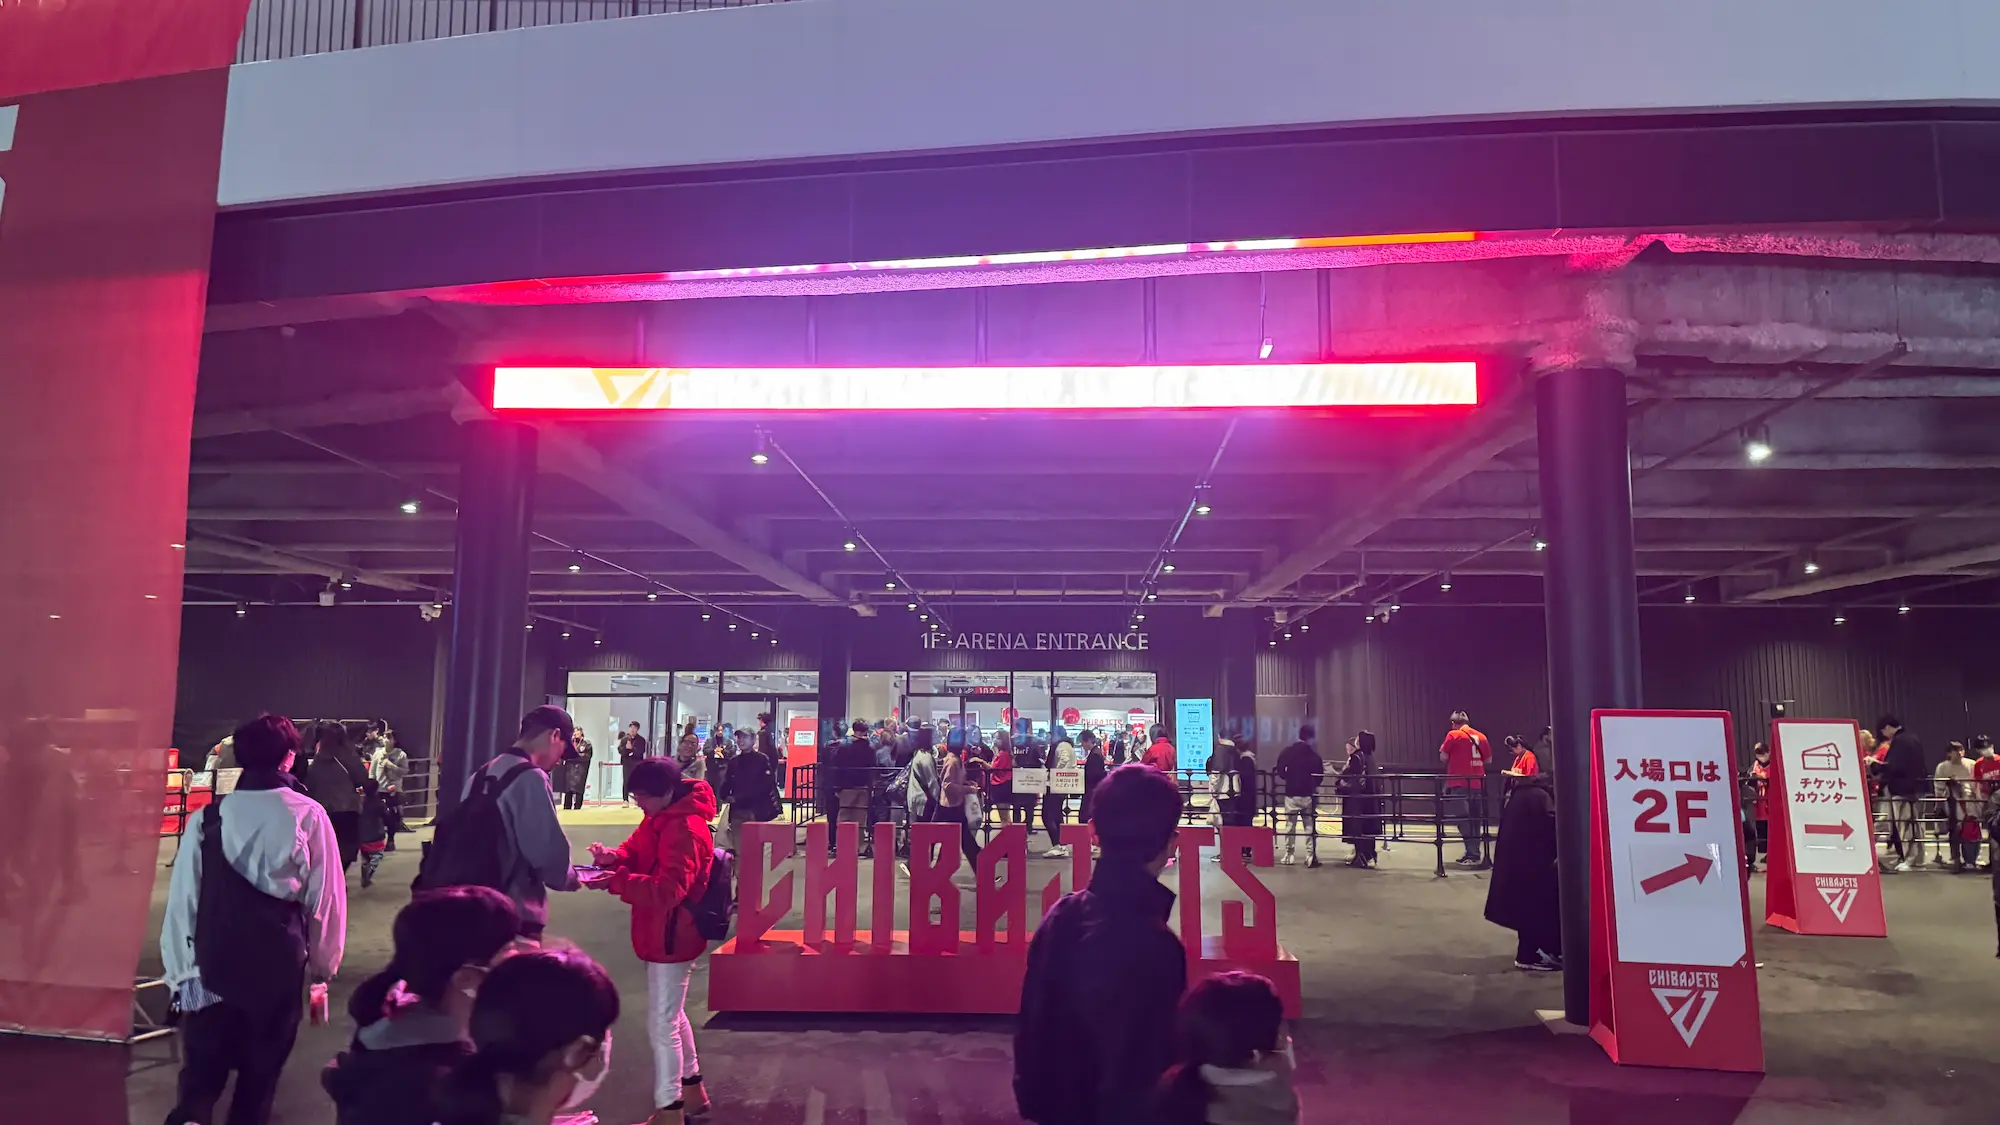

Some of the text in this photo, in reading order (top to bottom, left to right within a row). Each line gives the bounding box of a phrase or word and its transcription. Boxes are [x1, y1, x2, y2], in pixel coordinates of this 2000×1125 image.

[920, 632, 1149, 650] 1F ARENA ENTRANCE
[1613, 758, 1721, 782] 入場口は
[1799, 777, 1848, 790] チケット
[1794, 791, 1858, 804] カウンター
[1632, 788, 1709, 835] 2F
[734, 822, 1276, 957] CHIBAJTS
[1814, 876, 1859, 888] CHIBAJETS
[1648, 969, 1720, 989] CHIBAJETS
